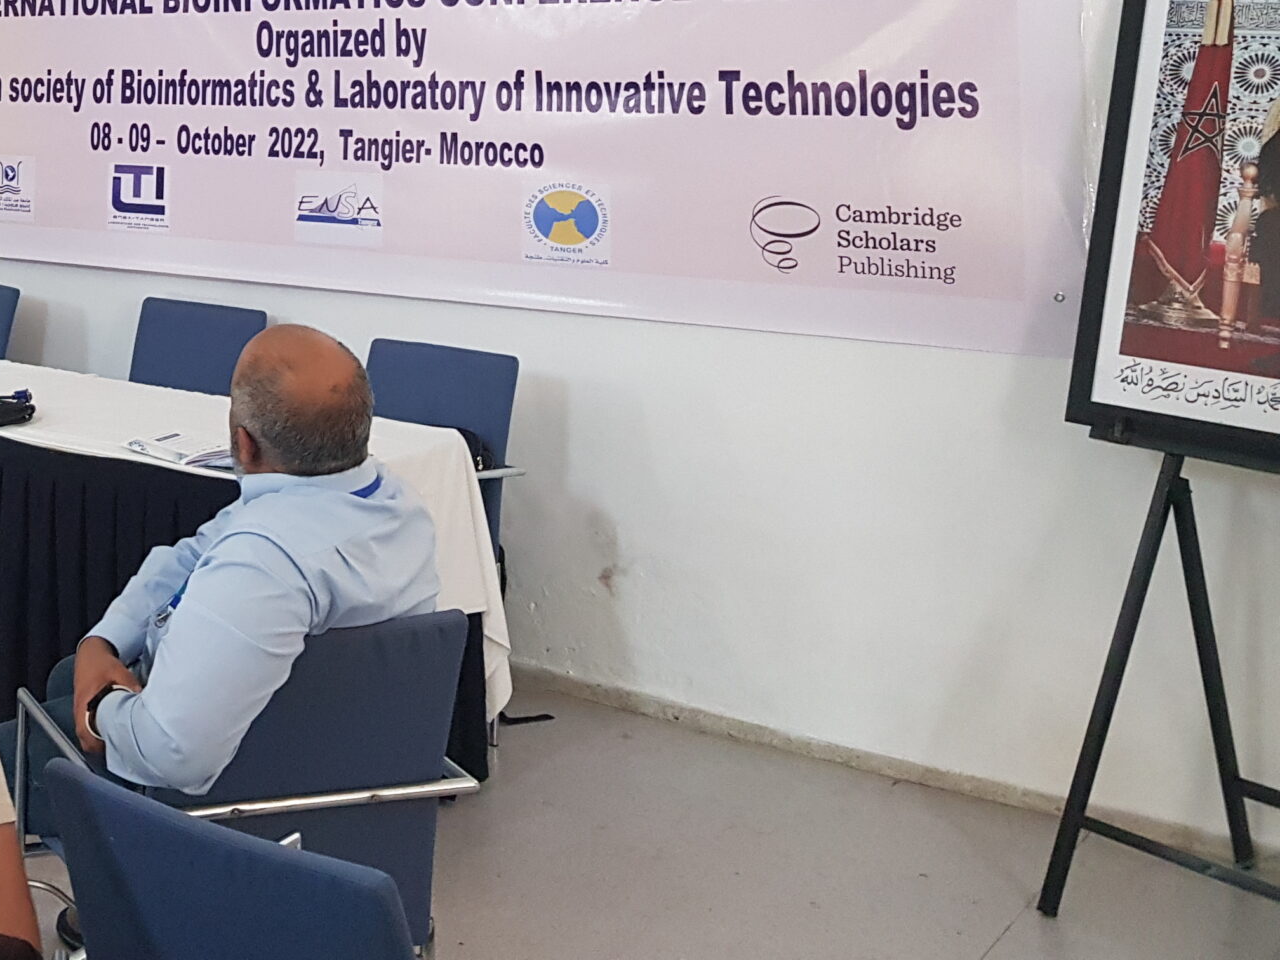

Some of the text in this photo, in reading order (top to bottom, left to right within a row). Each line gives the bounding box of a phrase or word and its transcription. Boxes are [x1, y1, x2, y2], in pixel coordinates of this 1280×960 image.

[256, 18, 426, 67] Organized by
[8, 69, 85, 111] society
[92, 69, 115, 104] of
[121, 69, 295, 108] Bioinformatics
[304, 70, 324, 108] &
[334, 70, 487, 121] Laboratory
[496, 70, 525, 112] of
[535, 70, 706, 115] Innovative
[719, 70, 979, 130] Technologies
[90, 122, 112, 152] 08
[177, 124, 256, 157] October
[268, 127, 325, 166] 2022,
[339, 129, 432, 172] Tangier-
[439, 132, 545, 169] Morocco
[298, 191, 379, 218] ENSA
[836, 203, 962, 231] Cambridge
[550, 246, 583, 254] TANGER
[837, 230, 937, 254] Scholars
[837, 255, 956, 284] Publishing
